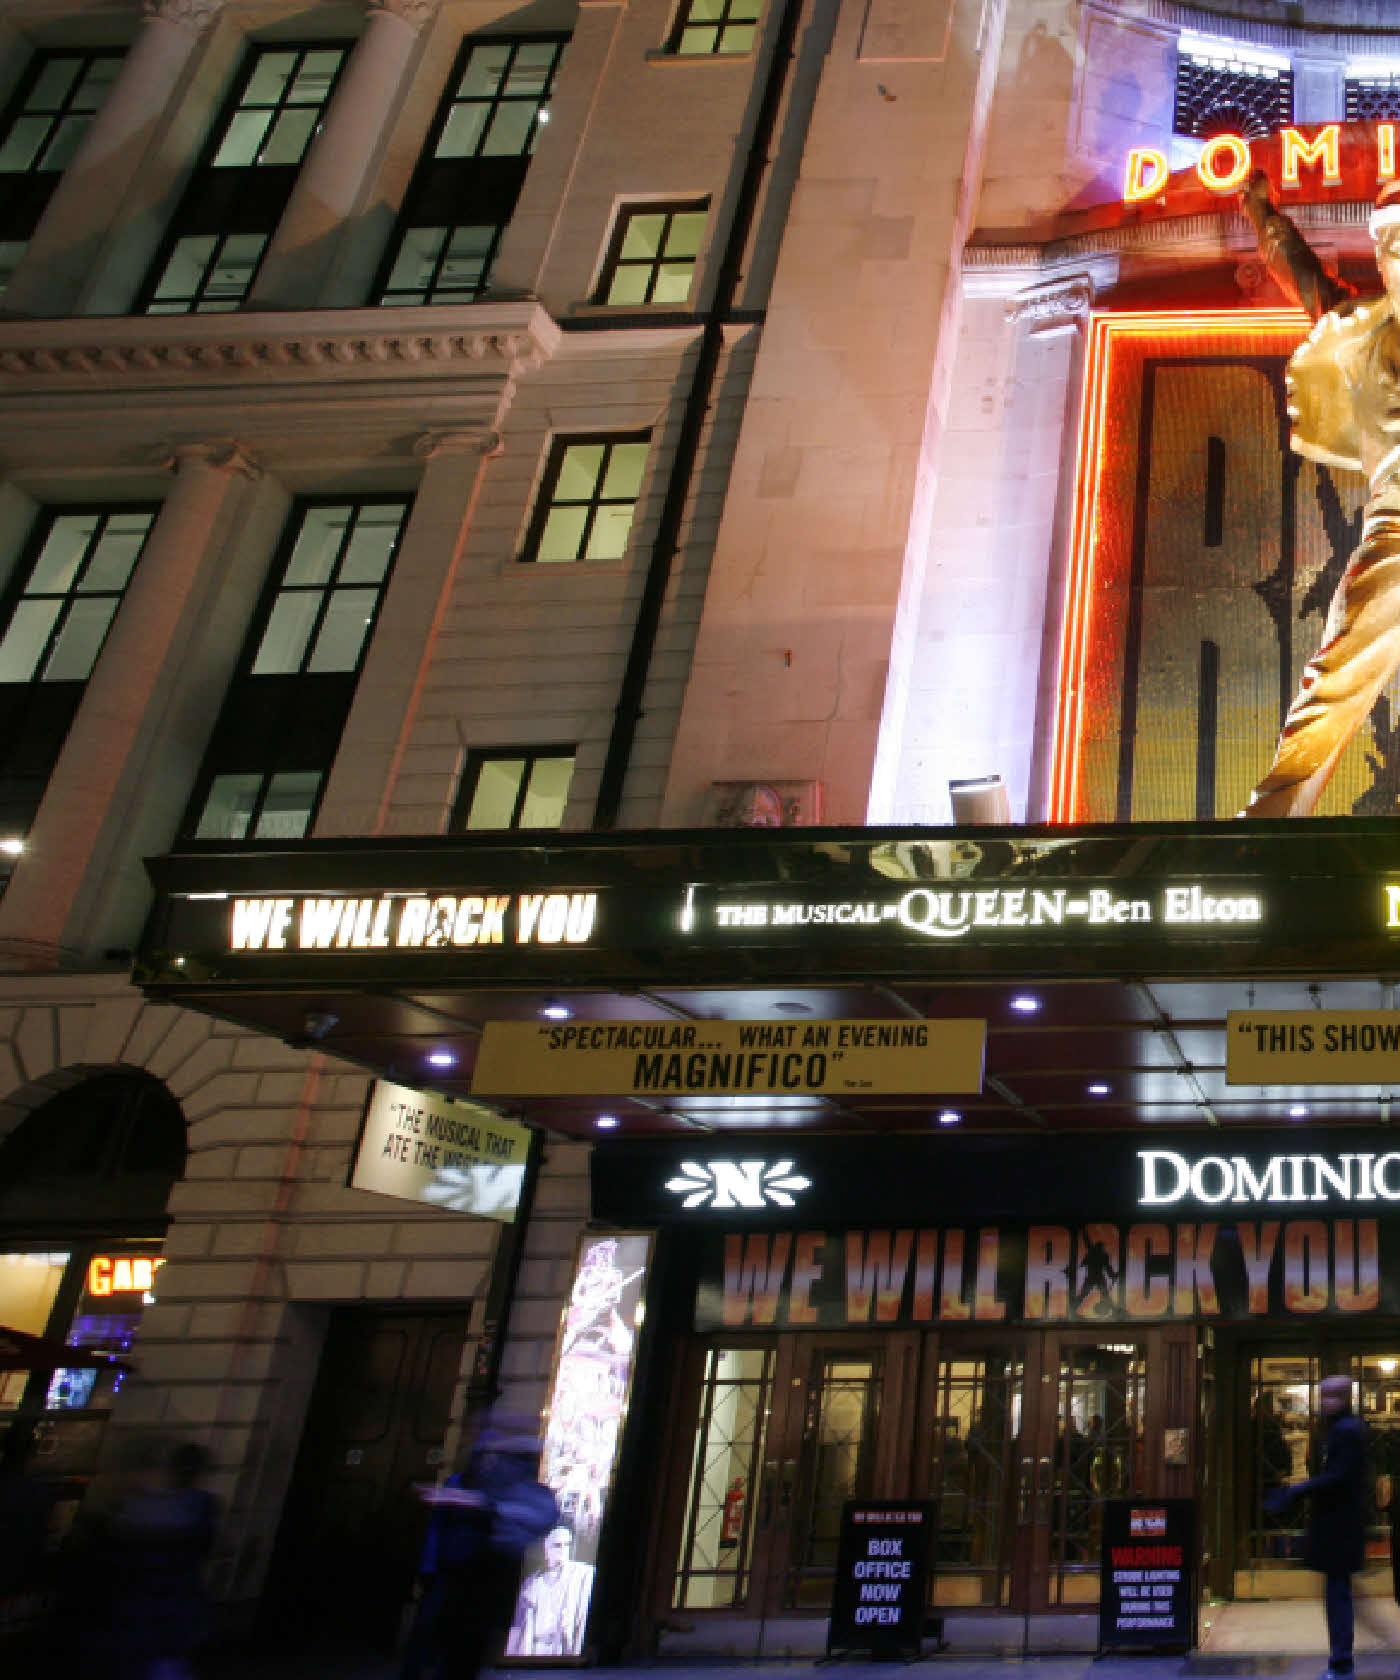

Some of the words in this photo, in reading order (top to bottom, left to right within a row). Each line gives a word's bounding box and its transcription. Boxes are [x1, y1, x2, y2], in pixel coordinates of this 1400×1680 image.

[230, 898, 294, 949] WE
[298, 897, 392, 949] WILL
[396, 895, 510, 947] ROCK
[516, 894, 598, 944] YOU
[716, 904, 768, 926] THE
[772, 903, 881, 925] MUSICAL
[899, 888, 1067, 938] QUEEN
[1087, 889, 1151, 923] Ben
[1164, 886, 1261, 922] Elton
[738, 1025, 798, 1048] WHAT
[801, 1025, 832, 1047] AN
[836, 1024, 929, 1047] EVENING
[1238, 1022, 1315, 1053] "THIS
[1324, 1022, 1400, 1052] SHOW
[633, 1051, 845, 1090] MAGNIFICO"
[383, 1132, 412, 1163] ATE
[414, 1140, 441, 1170] THE
[427, 1112, 482, 1152] MUSICAL
[485, 1131, 517, 1160] THAT
[723, 1229, 827, 1326] WE
[845, 1226, 1006, 1324] WILL
[1024, 1221, 1222, 1321] ROCK
[1237, 1217, 1380, 1315] YOU
[868, 1537, 904, 1557] BOX
[1111, 1545, 1184, 1568] WARNING
[854, 1561, 912, 1580] OFFICE
[860, 1583, 902, 1602] NOW
[855, 1605, 902, 1625] OPEN
